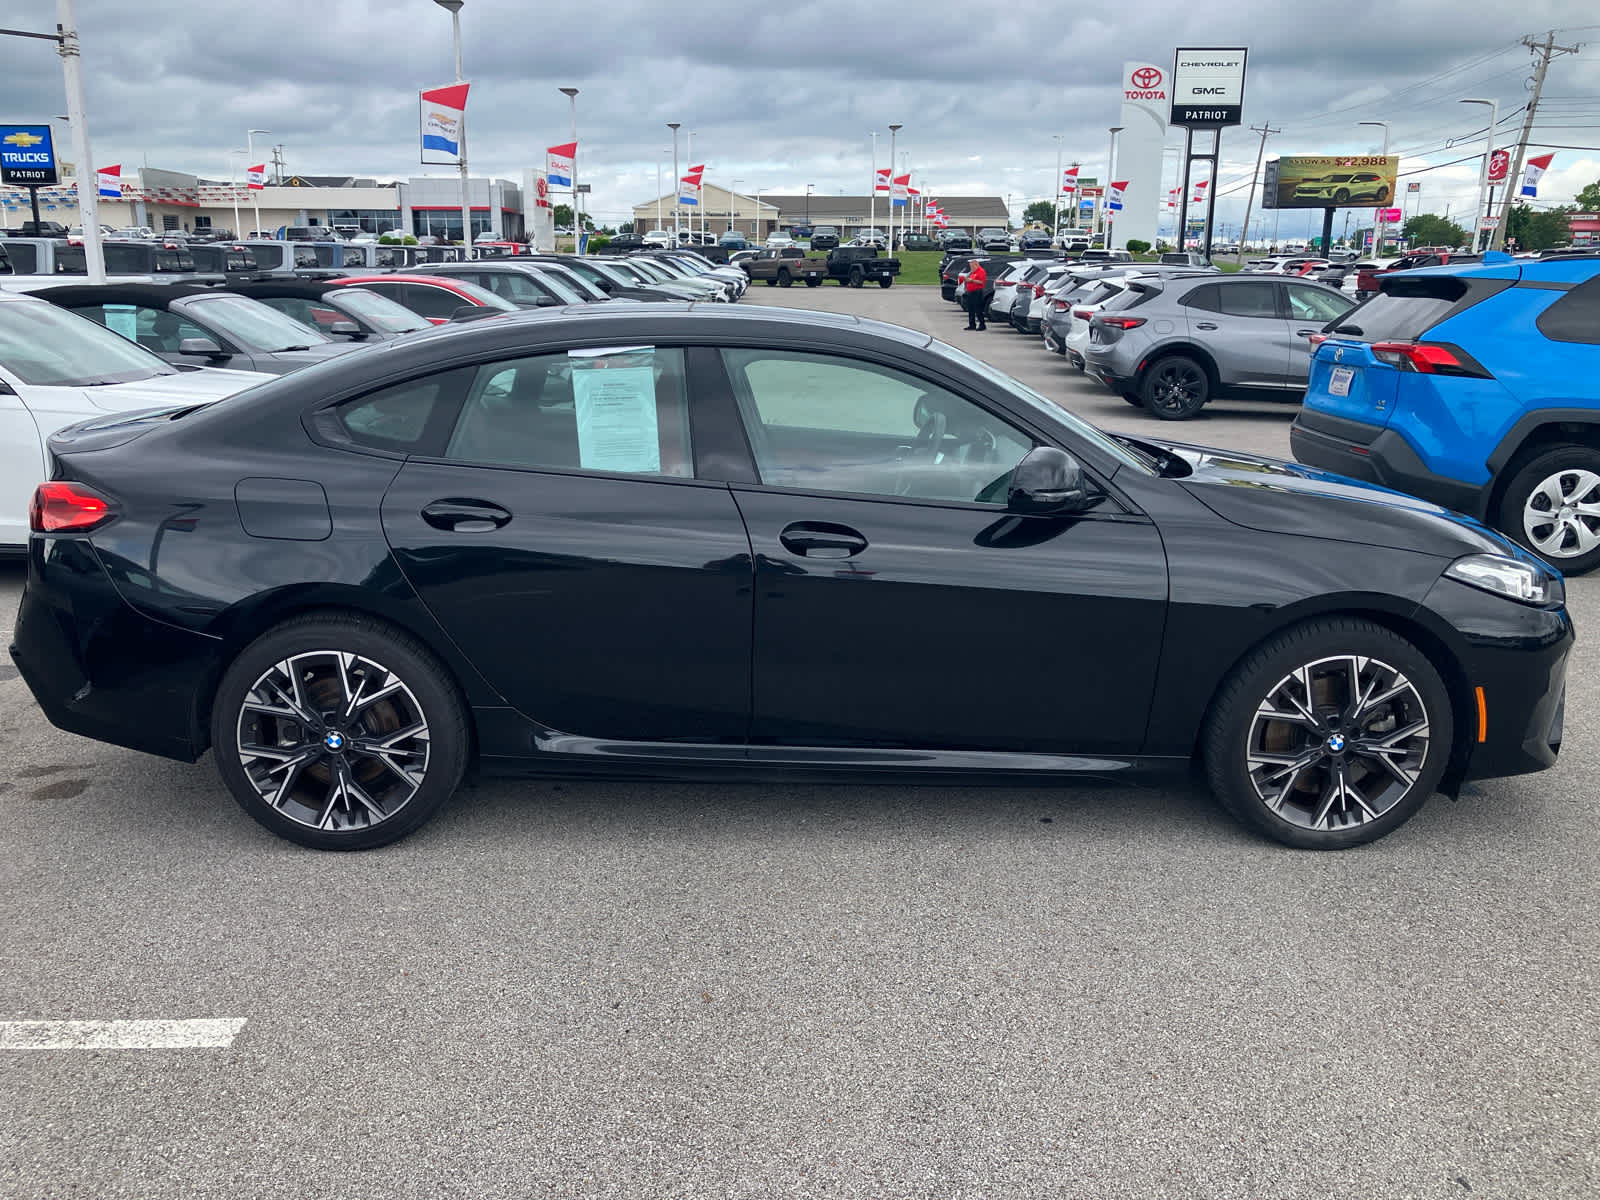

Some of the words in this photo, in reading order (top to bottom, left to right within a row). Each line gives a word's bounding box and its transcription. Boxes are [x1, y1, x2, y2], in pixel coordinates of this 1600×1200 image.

[1125, 91, 1166, 100] TOYOTA
[1192, 87, 1226, 96] GMC
[1185, 110, 1229, 120] PATRIOT
[2, 152, 49, 163] TRUCKS
[10, 170, 46, 179] PATRIOT
